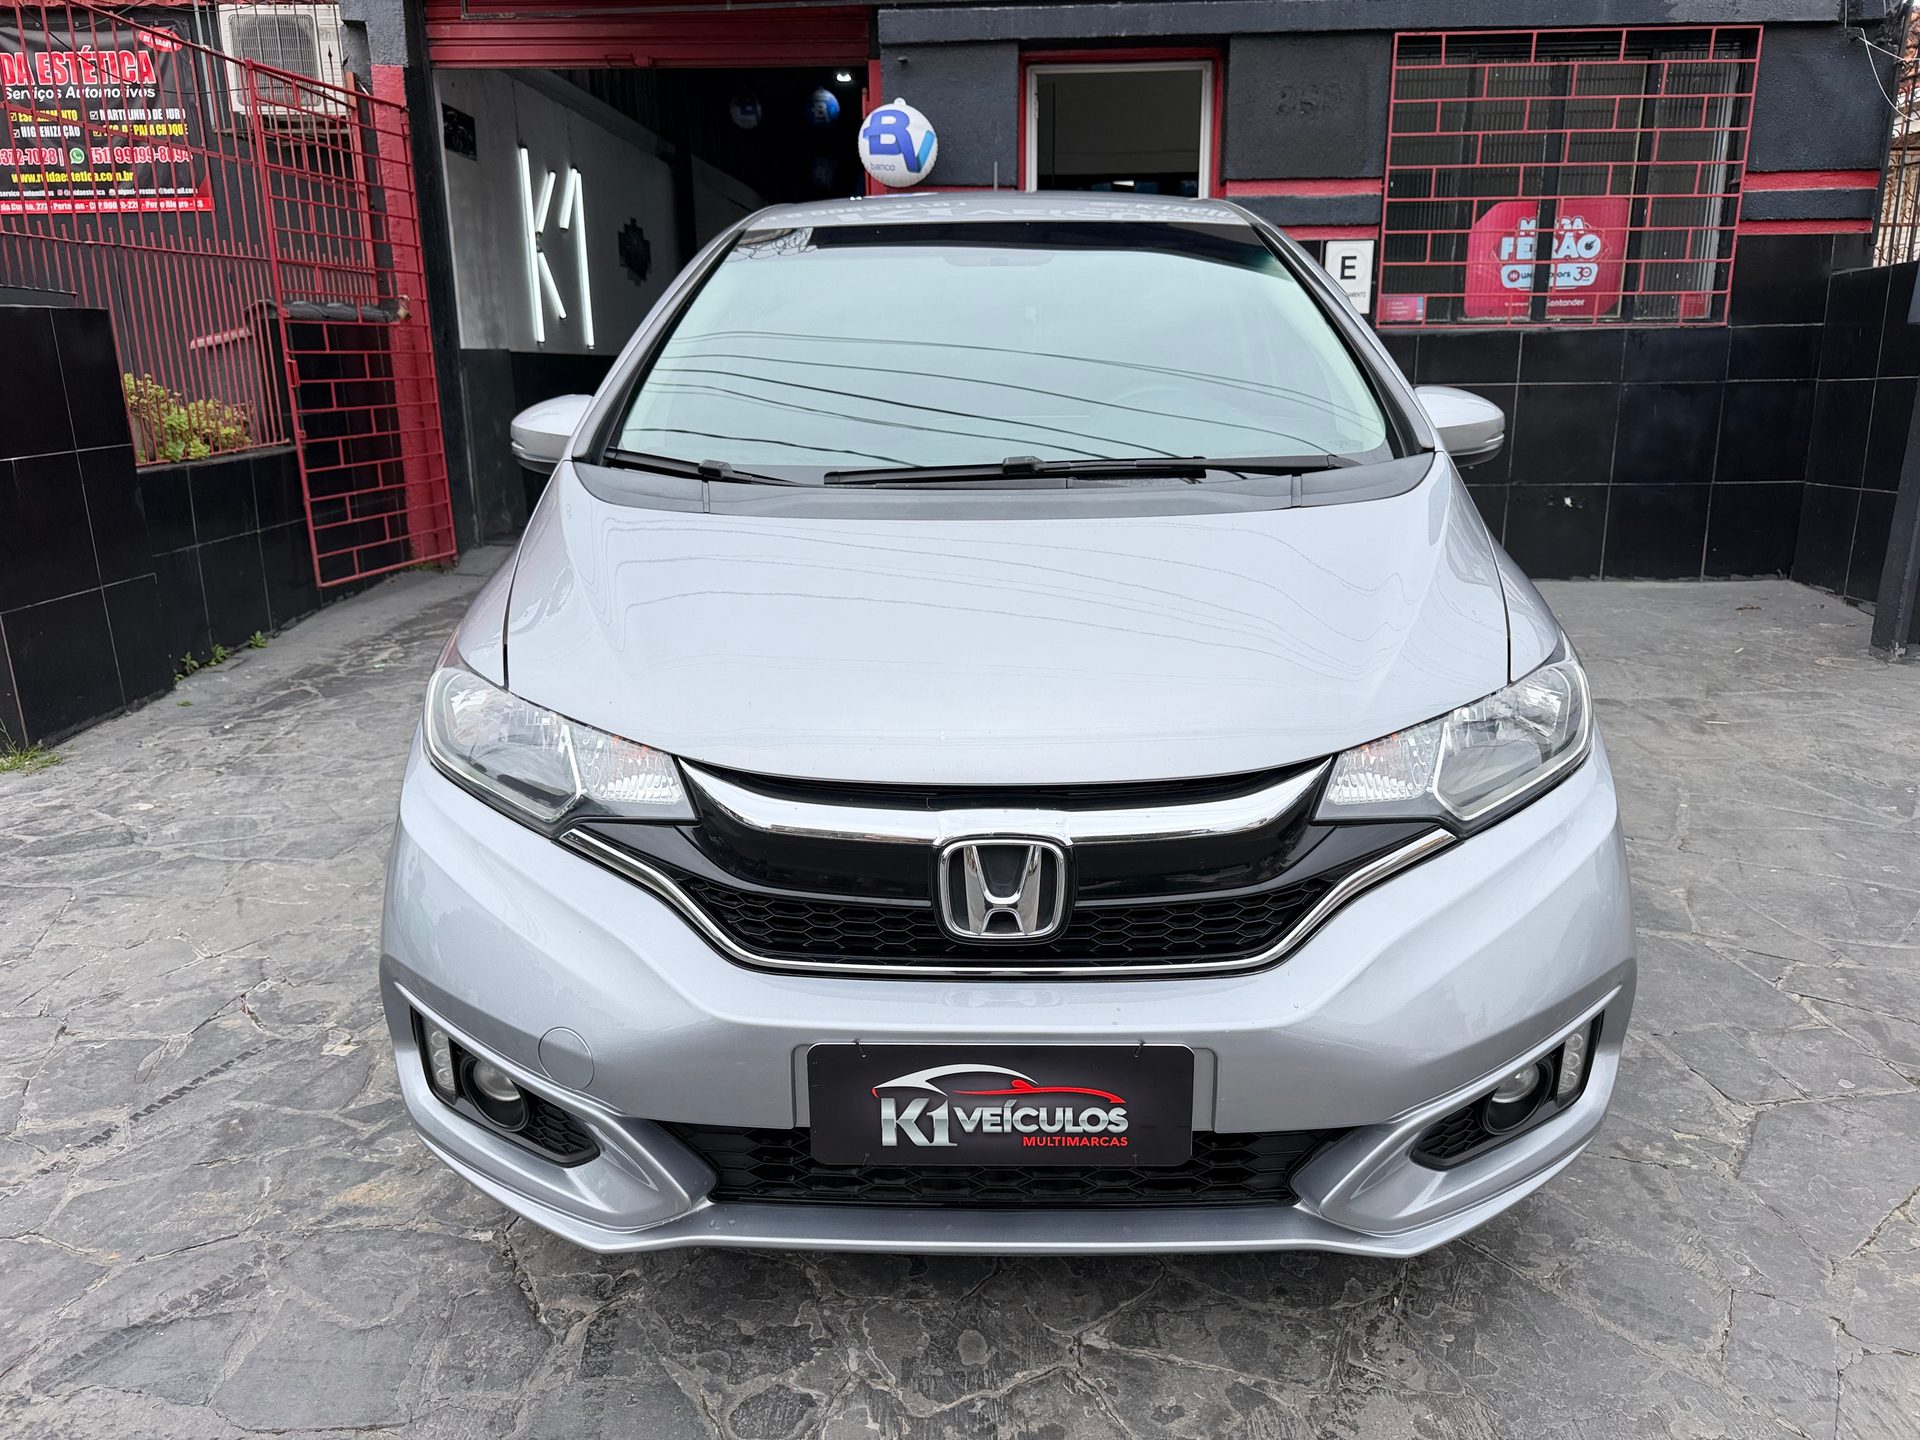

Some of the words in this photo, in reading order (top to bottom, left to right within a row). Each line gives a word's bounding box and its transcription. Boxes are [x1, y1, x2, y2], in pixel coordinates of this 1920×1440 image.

[35, 45, 157, 85] ESTÉTICA
[65, 86, 156, 99] Automoivos
[869, 163, 895, 171] banco
[1519, 218, 1585, 235] MGA
[1500, 232, 1601, 260] FEÃO
[1340, 256, 1357, 280] E
[880, 1098, 958, 1146] K1
[953, 1099, 1129, 1133] VEÍCULOS
[1023, 1136, 1129, 1147] MULTIMARCAS
